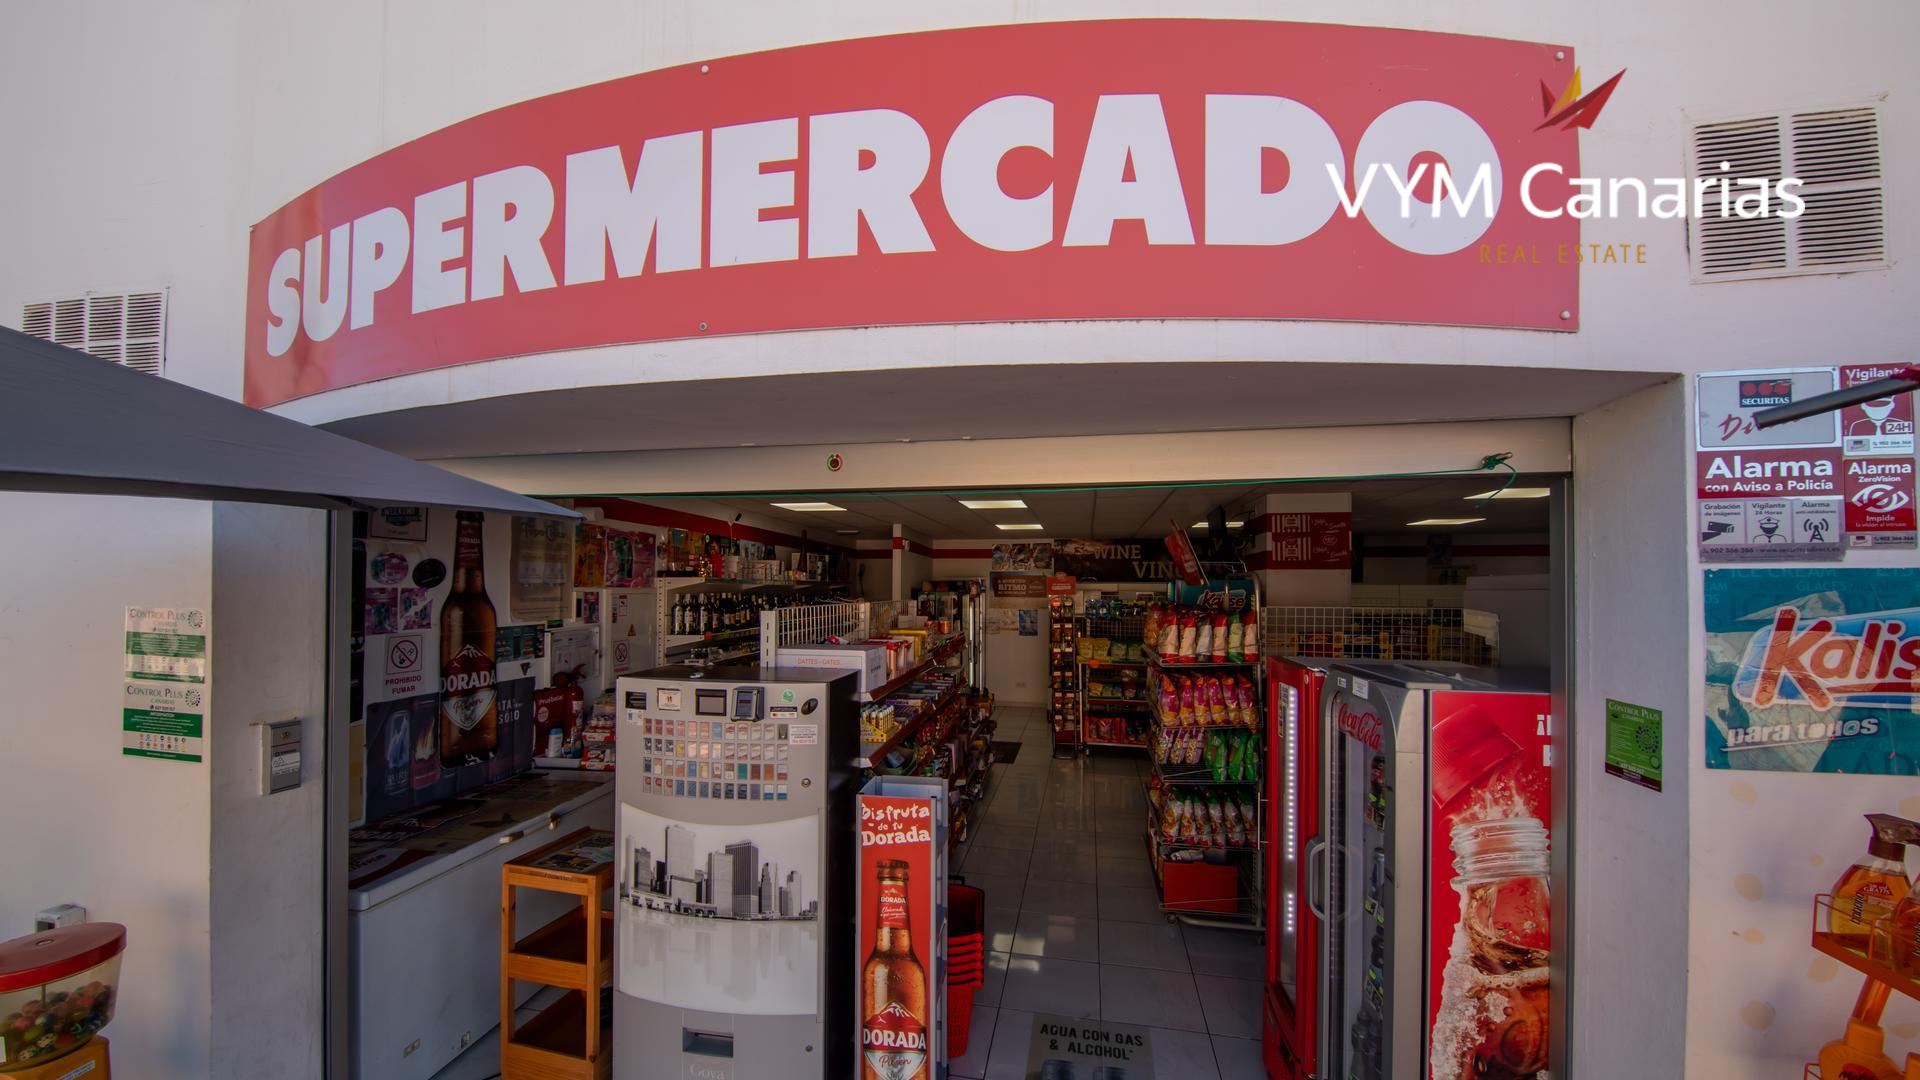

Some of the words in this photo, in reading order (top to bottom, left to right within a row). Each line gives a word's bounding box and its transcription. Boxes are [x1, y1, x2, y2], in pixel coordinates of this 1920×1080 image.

[266, 94, 1503, 357] SUPERMERCADO
[1741, 396, 1790, 406] SECURITAS
[1887, 422, 1912, 432] 24H
[1704, 455, 1833, 479] Alarma
[1847, 462, 1912, 475] Alarma
[1704, 483, 1729, 492] con
[1733, 481, 1771, 492] Aviso
[1775, 483, 1783, 491] a
[1787, 479, 1834, 491] Policía
[1752, 502, 1786, 511] Vigilante
[1866, 514, 1896, 523] Impide
[1093, 544, 1142, 560] WINE
[385, 675, 422, 686] PROHIBIDO
[440, 670, 497, 692] DORADA
[392, 685, 417, 695] FUMAR
[1727, 722, 1792, 745] para
[861, 802, 930, 822] Disfruta
[861, 825, 931, 847] Dorada
[880, 896, 907, 904] DORADA
[863, 1028, 927, 1049] DORADA
[1040, 1023, 1077, 1038] AGUA
[1082, 1029, 1110, 1042] CON
[1115, 1033, 1143, 1047] GAS
[1049, 1038, 1058, 1050] &
